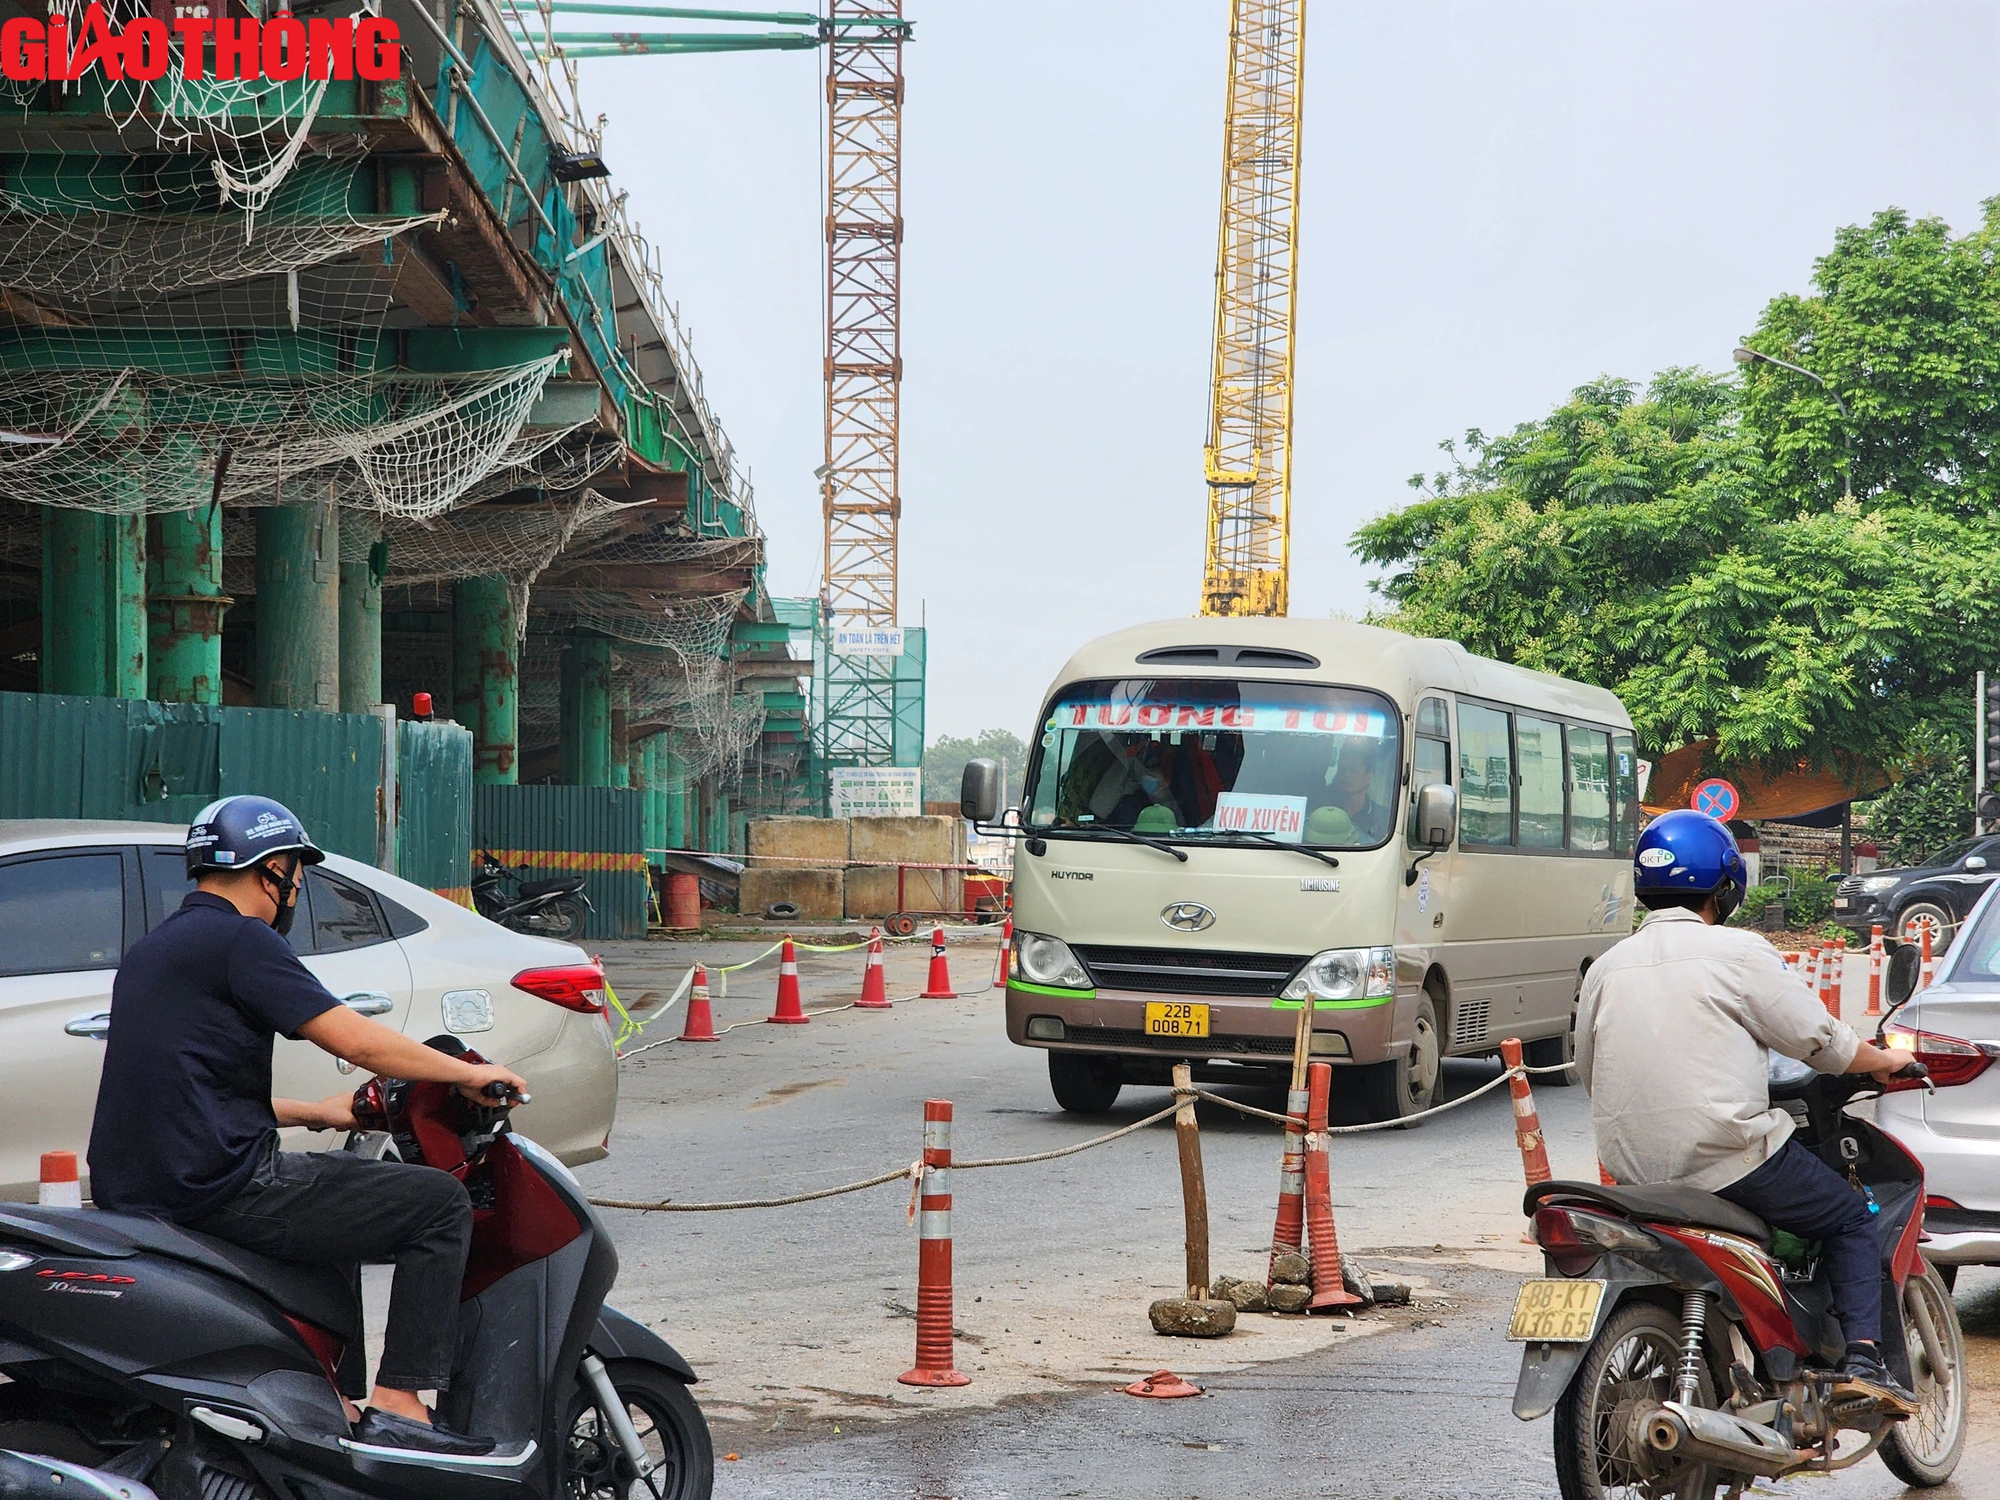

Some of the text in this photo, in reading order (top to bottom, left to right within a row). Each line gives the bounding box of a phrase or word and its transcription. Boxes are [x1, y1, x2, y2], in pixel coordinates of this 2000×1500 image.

[1218, 805, 1301, 833] KIM XUYÊN
[1300, 878, 1340, 892] LIMOUSINE
[1164, 1004, 1191, 1019] 22B
[1152, 1019, 1201, 1035] 008.71
[1528, 1283, 1591, 1309] 88-K1
[1514, 1311, 1591, 1337] 036.65
